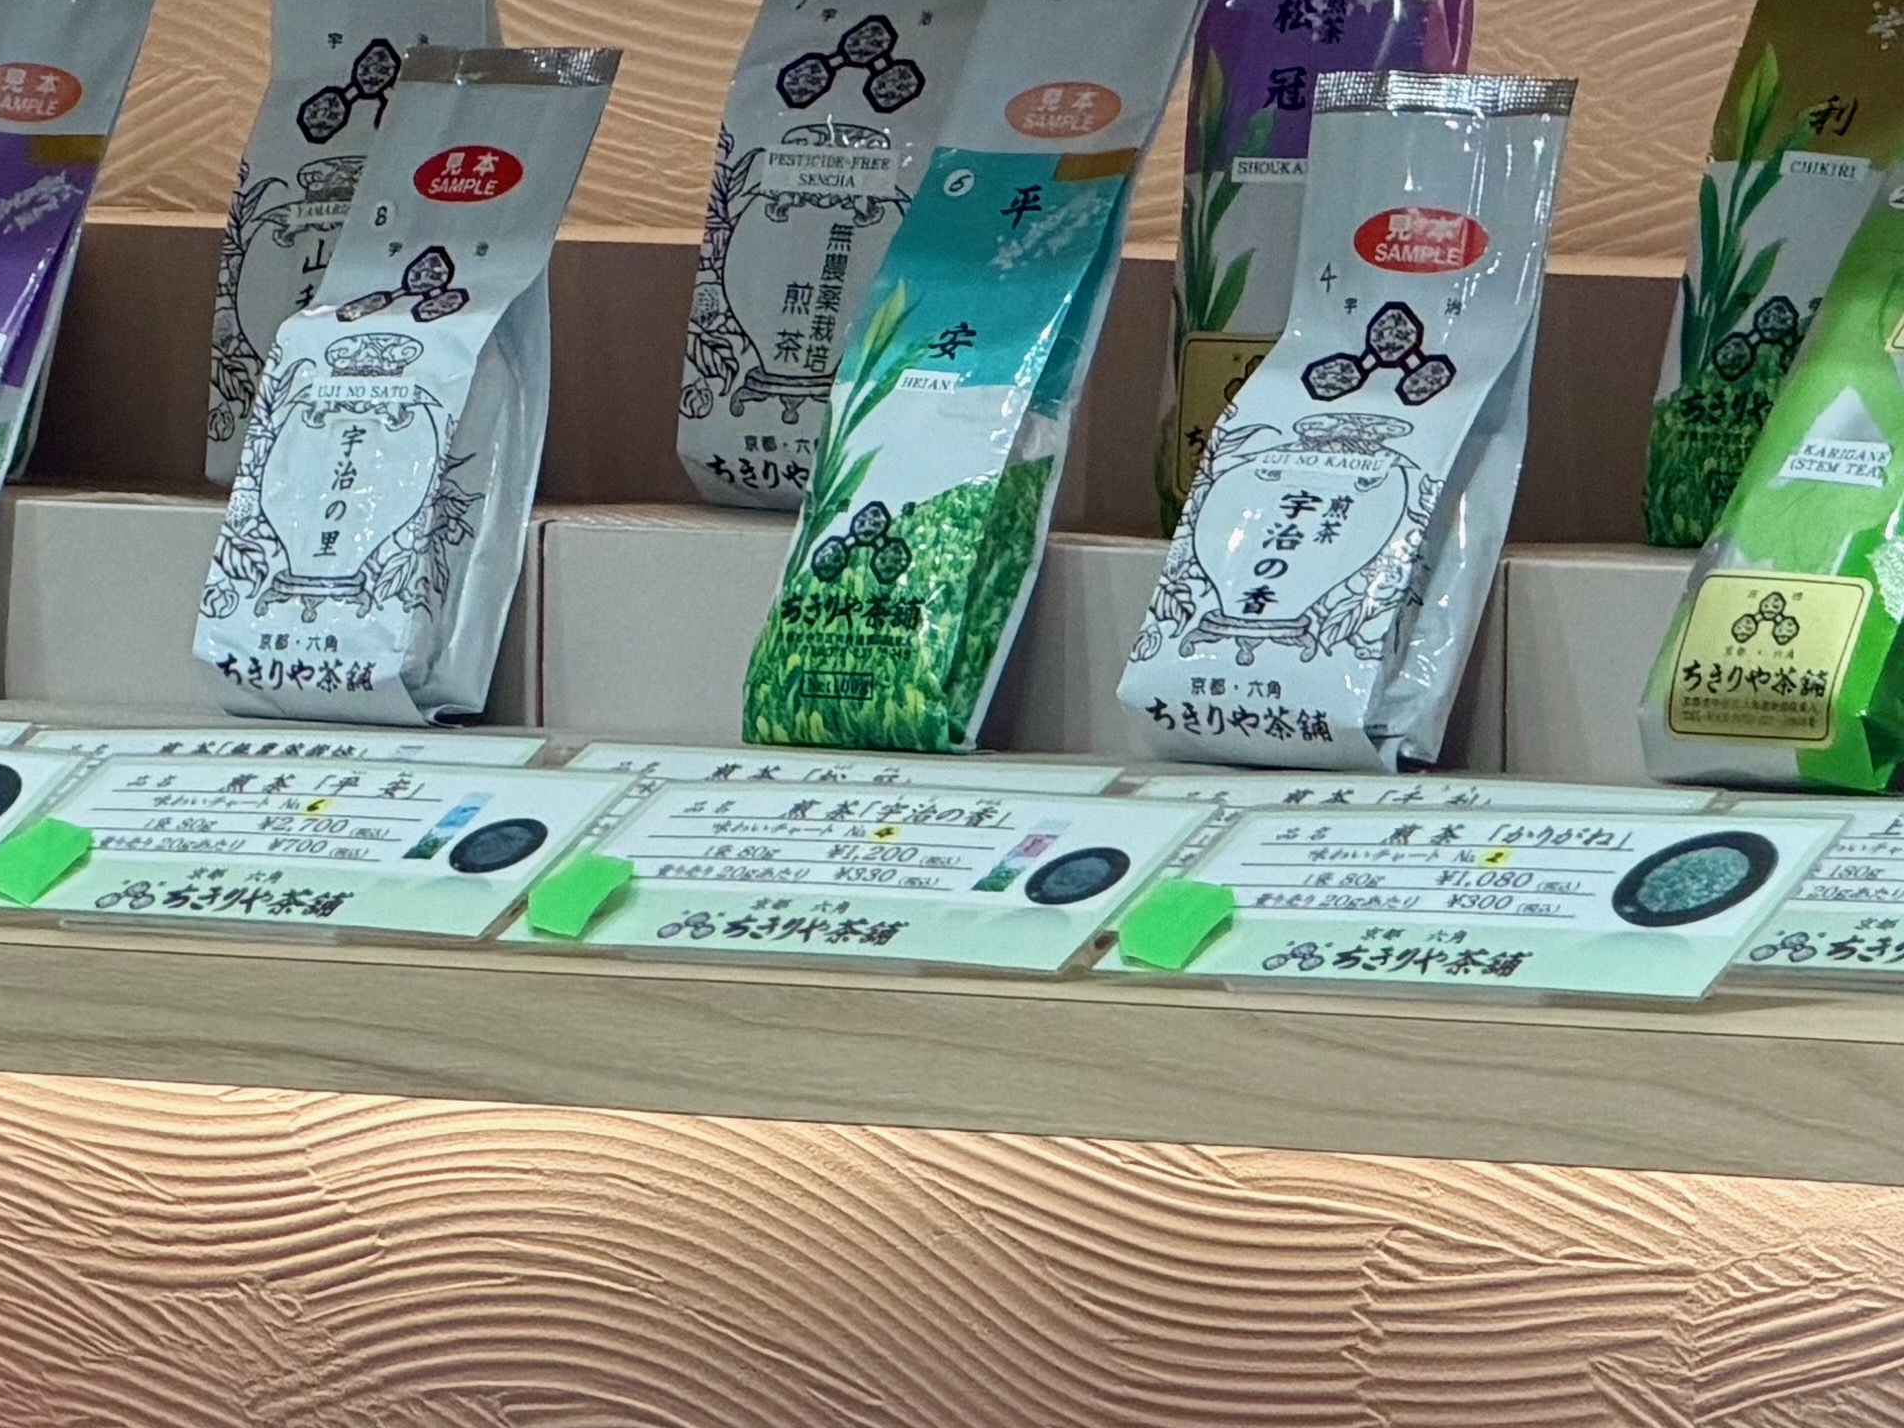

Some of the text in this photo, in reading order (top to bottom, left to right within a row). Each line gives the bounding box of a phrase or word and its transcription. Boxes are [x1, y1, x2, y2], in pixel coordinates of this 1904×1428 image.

[1019, 109, 1096, 133] SAMPLE
[440, 152, 499, 178] 見本
[769, 153, 891, 172] PESTICIDE-FREE
[1790, 160, 1857, 179] CHIKIRI
[427, 175, 499, 198] SAMPLE
[1374, 242, 1460, 265] SAMPLE
[804, 223, 855, 373] 無農薬栽培
[773, 282, 815, 364] 煎茶
[318, 386, 409, 398] UJI NO SATO
[899, 375, 954, 392] HEIAN
[1263, 453, 1388, 472] UJI KAORU
[1803, 444, 1890, 463] KARIGANE
[1790, 459, 1838, 475] (STEM
[314, 424, 367, 558] 宇治の里
[1310, 494, 1355, 546] 煎茶
[1236, 489, 1325, 616] 宇治の香
[258, 633, 339, 655] 京都・六角
[217, 652, 375, 694] ちきりや茶舗
[1681, 660, 1829, 698] ちきりや茶舗
[1189, 677, 1283, 701] 京都・六角
[1145, 696, 1334, 745] ちきりや茶舗
[257, 815, 352, 835] ¥2,700
[1487, 825, 1636, 851] 「かりがね」
[826, 844, 921, 864] ¥1,200
[1433, 870, 1535, 891] ¥1,080
[162, 878, 357, 918] ちきりや茶舗
[1444, 894, 1515, 912] ¥300
[725, 918, 910, 946] ちきりや茶舗
[1331, 944, 1534, 981] ちきりや茶舗
